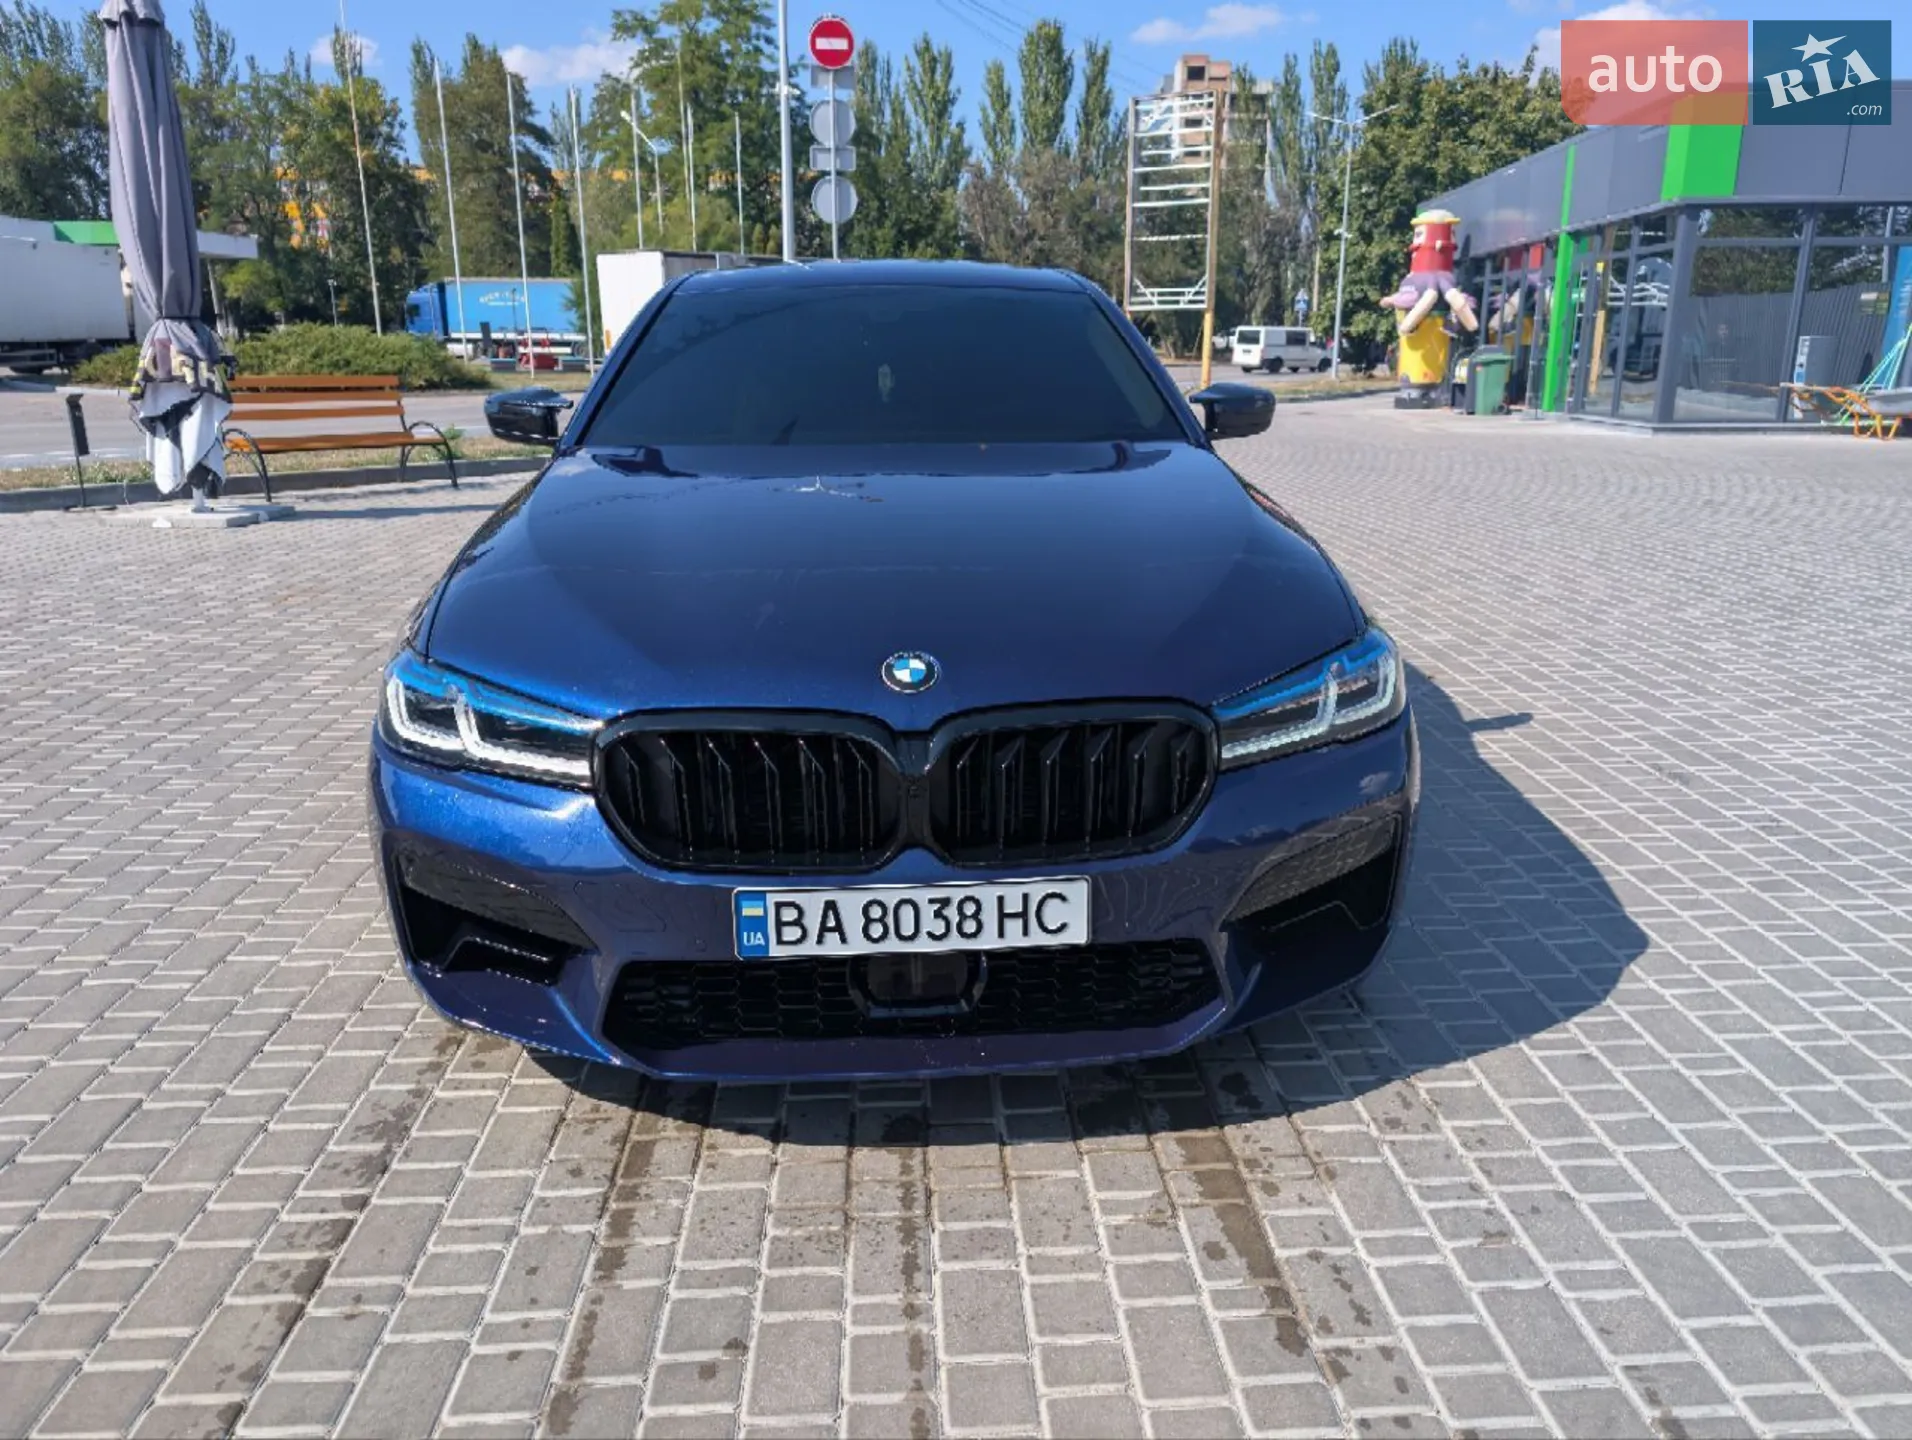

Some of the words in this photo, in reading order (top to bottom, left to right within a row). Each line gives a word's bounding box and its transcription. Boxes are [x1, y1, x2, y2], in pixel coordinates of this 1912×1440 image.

[774, 898, 849, 946] BA
[860, 895, 983, 944] 8038
[996, 891, 1070, 939] HC
[743, 931, 765, 946] UA
